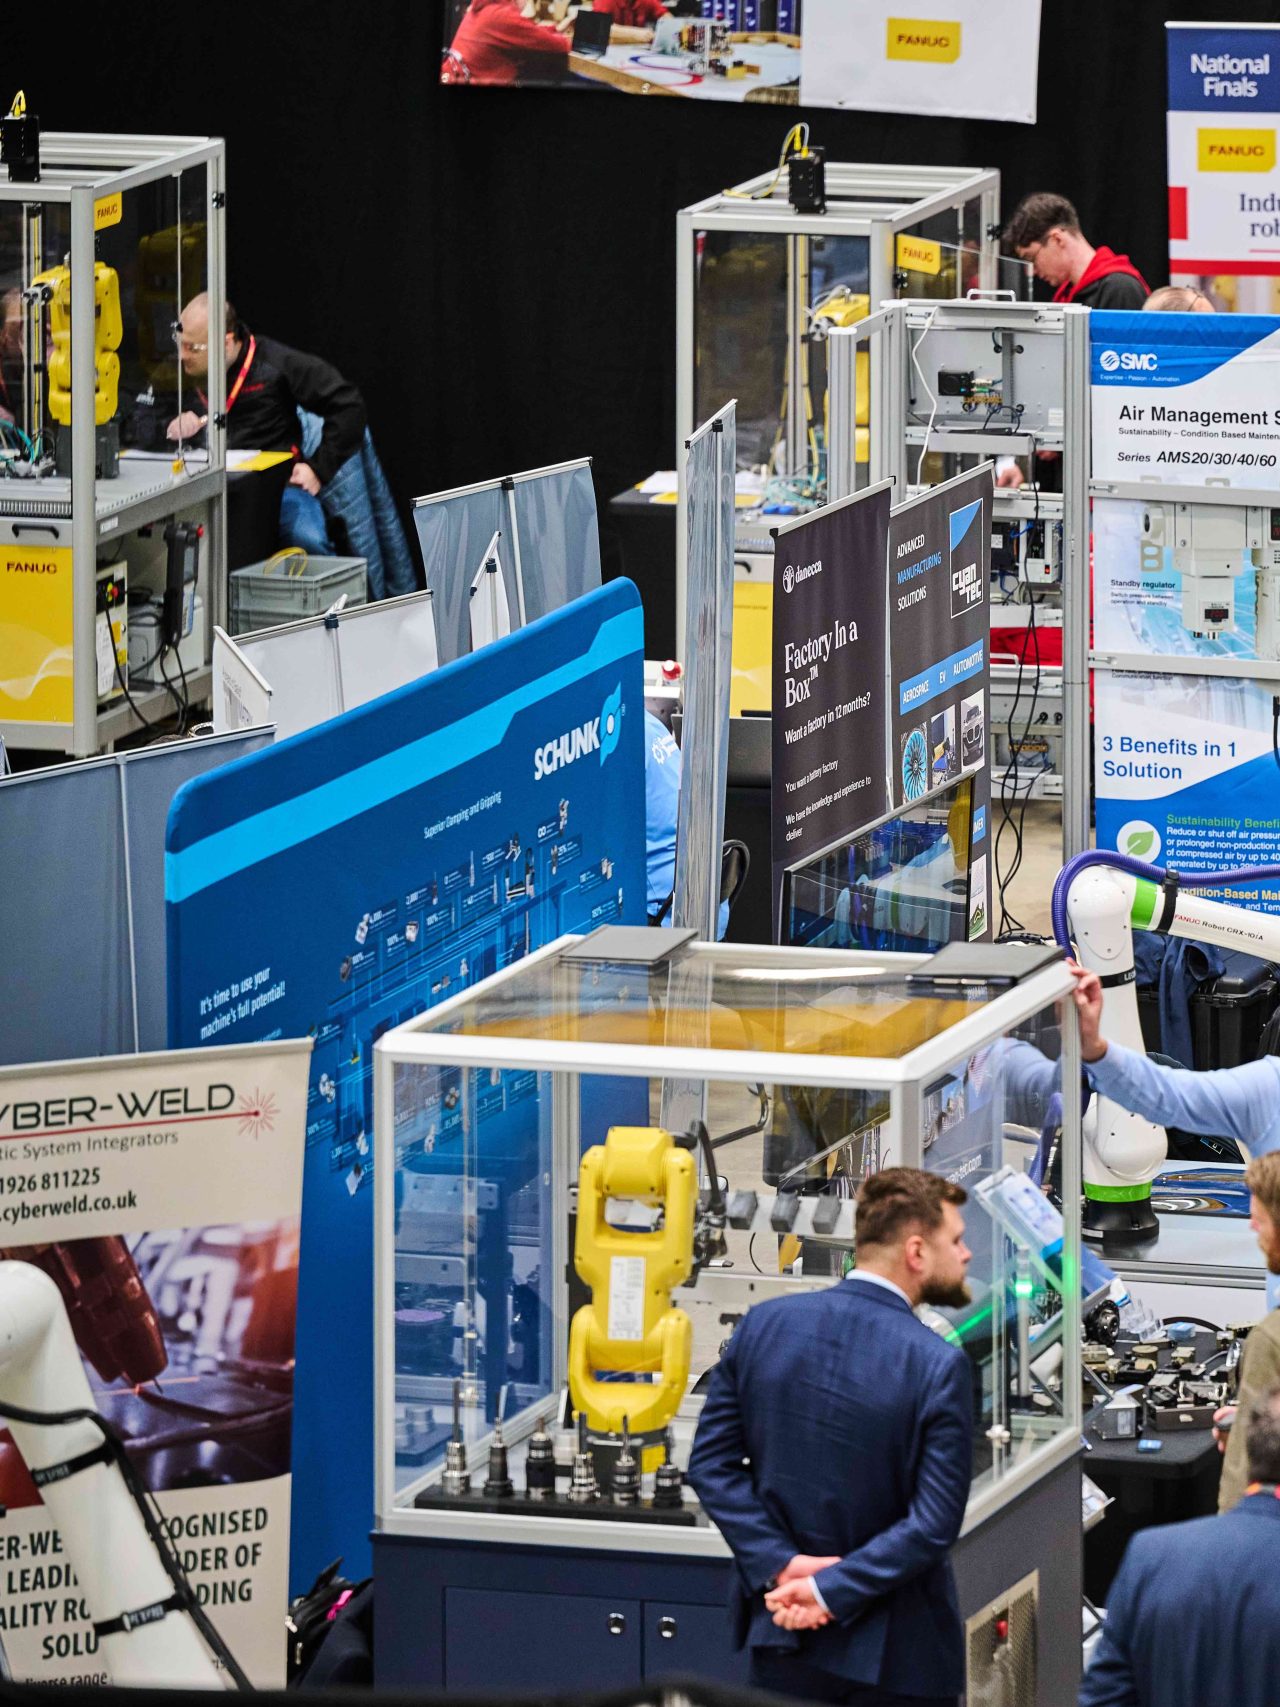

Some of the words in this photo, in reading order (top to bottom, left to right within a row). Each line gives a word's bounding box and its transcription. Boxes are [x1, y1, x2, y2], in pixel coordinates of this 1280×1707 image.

[897, 34, 949, 48] FANUC
[1190, 53, 1270, 75] National
[1203, 77, 1258, 97] Finals
[1208, 145, 1265, 157] FANUC
[97, 205, 117, 218] FANUC
[904, 247, 933, 263] FANUC
[1120, 352, 1158, 371] SMC
[1119, 404, 1145, 422] Air
[1150, 405, 1269, 427] Management
[1118, 427, 1172, 439] Sustainability
[1180, 429, 1220, 439] Condition
[1221, 430, 1247, 440] Based
[1117, 451, 1151, 463] Series
[1156, 450, 1277, 468] AMS20/30/40/60
[897, 533, 925, 559] ADVANCED
[6, 561, 57, 575] FANUC
[795, 560, 822, 583] danecca
[896, 551, 942, 585] MANUFACTURING
[1110, 579, 1141, 588] Standby
[1142, 580, 1176, 589] regulator
[897, 585, 927, 611] SOLUTIONS
[784, 632, 833, 674] Factory
[849, 620, 859, 642] a
[902, 679, 930, 705] AEROSPACE
[939, 671, 946, 684] EV
[953, 648, 983, 676] AUTOMOTIVE
[785, 726, 804, 745] Want
[807, 714, 827, 735] factory
[827, 709, 835, 723] in
[834, 705, 843, 720] 12
[842, 691, 871, 717] months?
[534, 717, 601, 781] SCHUNK
[1103, 736, 1113, 752] 3
[1120, 736, 1199, 757] Benefits
[1203, 740, 1221, 757] in
[1227, 741, 1236, 757] 1
[1103, 760, 1183, 780] Solution
[785, 780, 797, 793] You
[424, 820, 446, 839] Superior
[469, 801, 480, 816] and
[480, 791, 501, 810] Gripping
[785, 812, 796, 826] We
[833, 787, 842, 802] and
[1166, 814, 1241, 829] Sustainability
[785, 826, 804, 843] deliver
[1166, 827, 1198, 836] Reduce
[1207, 829, 1226, 837] shut
[1226, 829, 1237, 838] off
[1238, 831, 1250, 839] air
[1176, 837, 1215, 850] prolonged
[1216, 839, 1276, 851] non-production
[1166, 860, 1206, 870] generated
[1207, 861, 1217, 871] by
[1218, 863, 1228, 871] up
[1176, 850, 1223, 860] compressed
[1224, 852, 1235, 860] air
[1236, 853, 1246, 862] by
[1248, 854, 1259, 862] up
[1260, 853, 1269, 861] to
[1245, 902, 1261, 911] and
[1174, 914, 1201, 925] FANUC
[1202, 920, 1226, 932] Robot
[200, 996, 213, 1016] It's
[213, 989, 231, 1008] time
[231, 983, 240, 999] to
[240, 976, 253, 994] use
[254, 967, 271, 991] your
[201, 1007, 237, 1040] machine's
[238, 998, 250, 1019] full
[251, 980, 286, 1016] potential!
[22, 1141, 82, 1162] System
[87, 1130, 179, 1152] Integrators
[41, 1167, 101, 1190] 811225
[235, 1543, 262, 1568] OF
